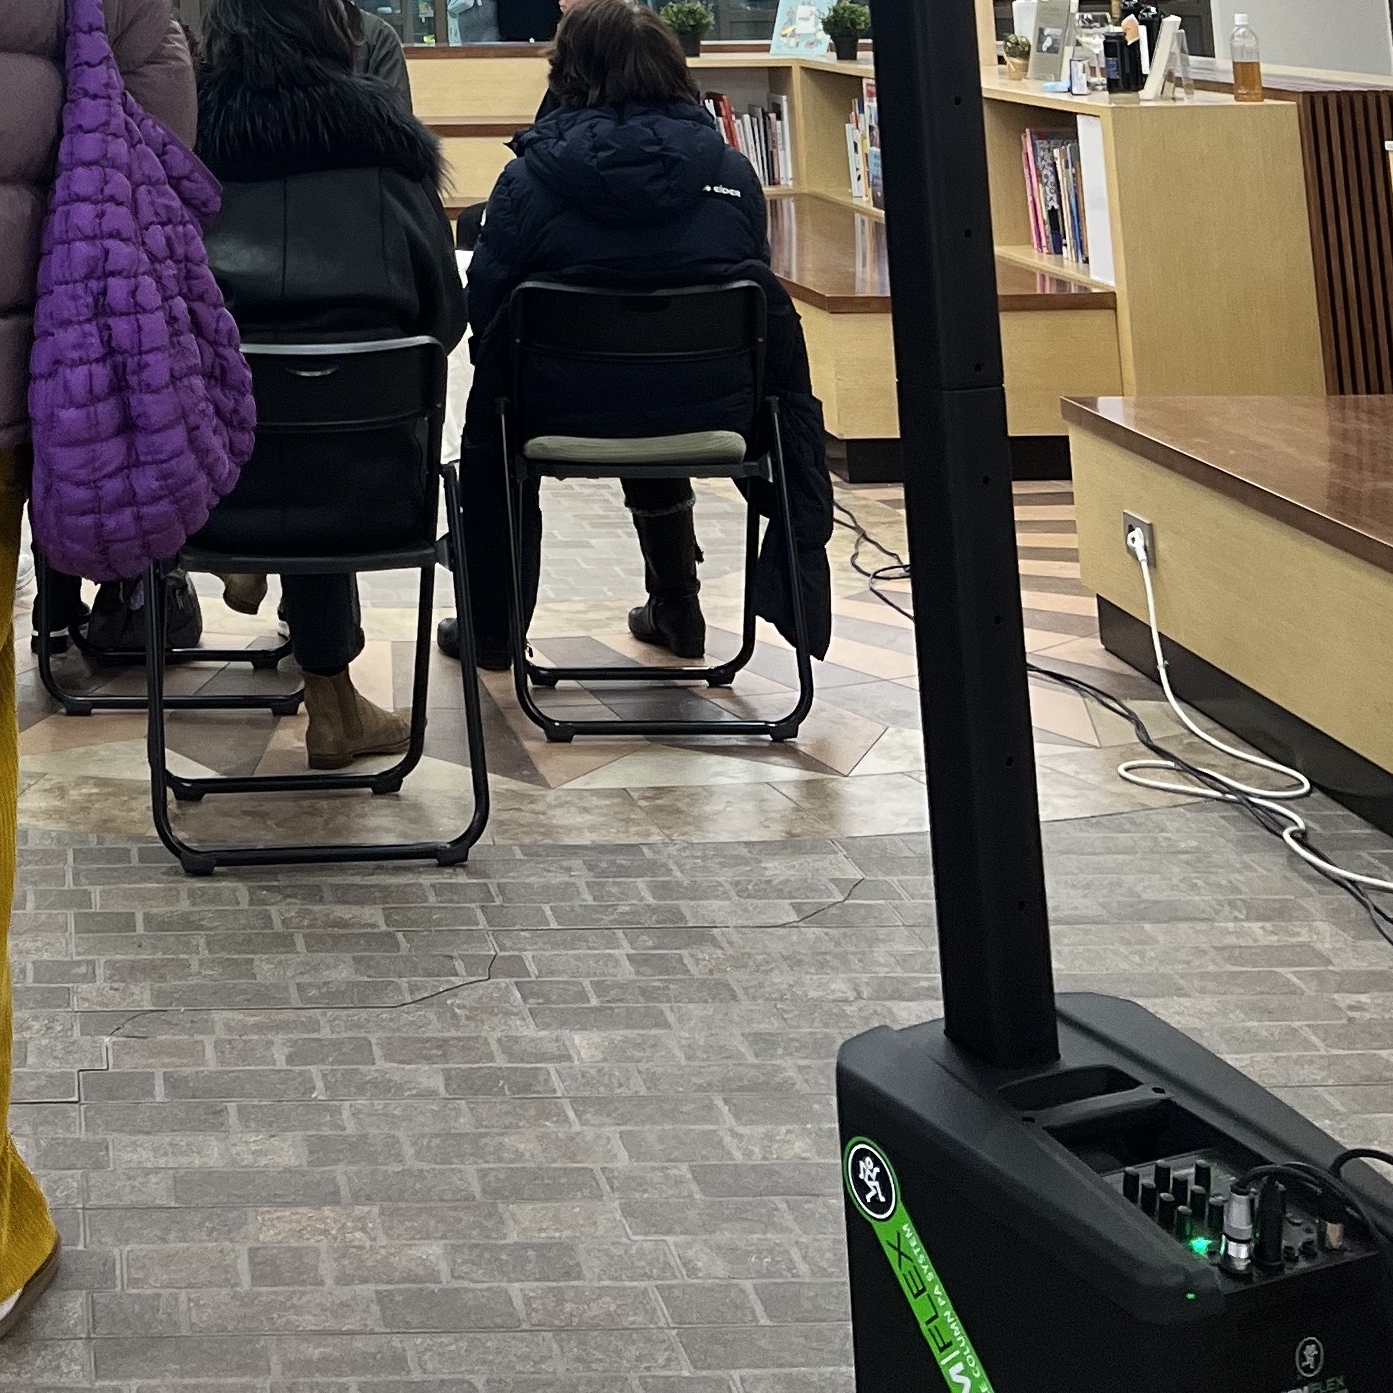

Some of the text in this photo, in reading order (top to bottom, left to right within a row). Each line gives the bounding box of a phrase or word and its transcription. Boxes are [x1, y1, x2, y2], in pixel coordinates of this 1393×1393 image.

[902, 1223, 981, 1378] COLUMN PA SYSTEM
